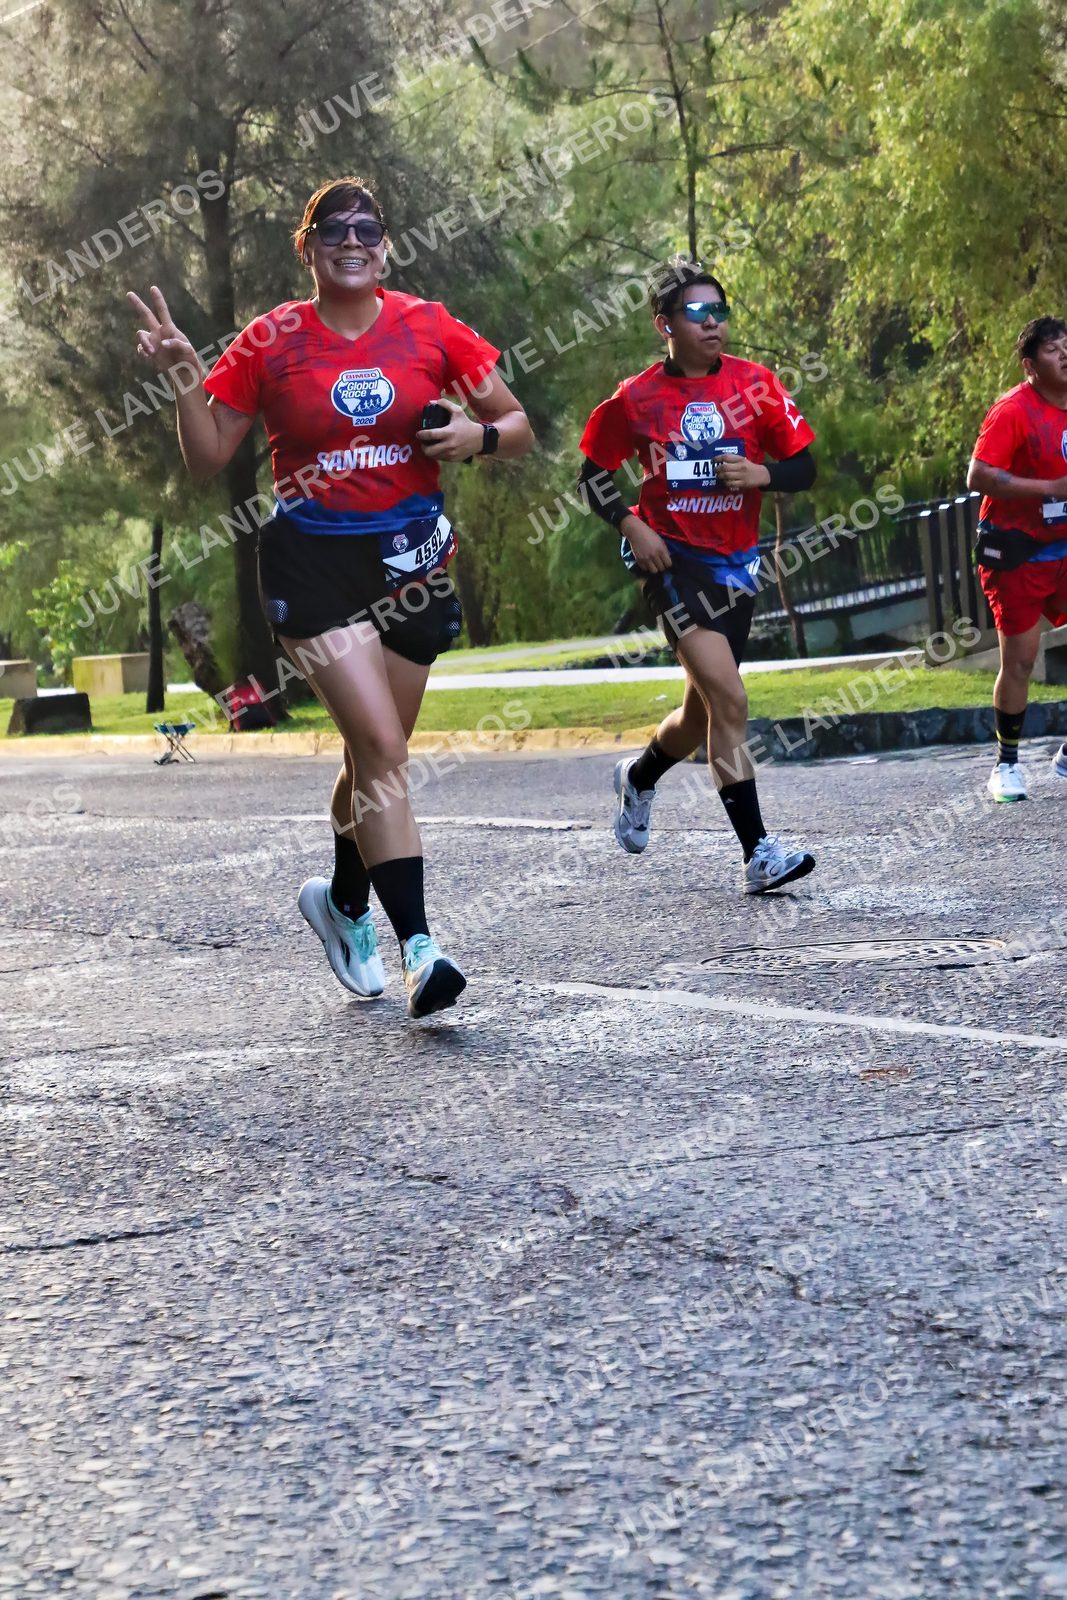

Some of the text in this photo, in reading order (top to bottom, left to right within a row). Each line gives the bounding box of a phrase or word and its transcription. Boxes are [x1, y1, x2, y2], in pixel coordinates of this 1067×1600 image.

[345, 372, 377, 380] BIMBO
[347, 380, 378, 391] Global
[341, 389, 367, 399] Race
[354, 417, 375, 426] 2026
[316, 443, 413, 471] SANTIAGO
[666, 494, 743, 513] SANTIAGO
[415, 527, 444, 565] 4592
